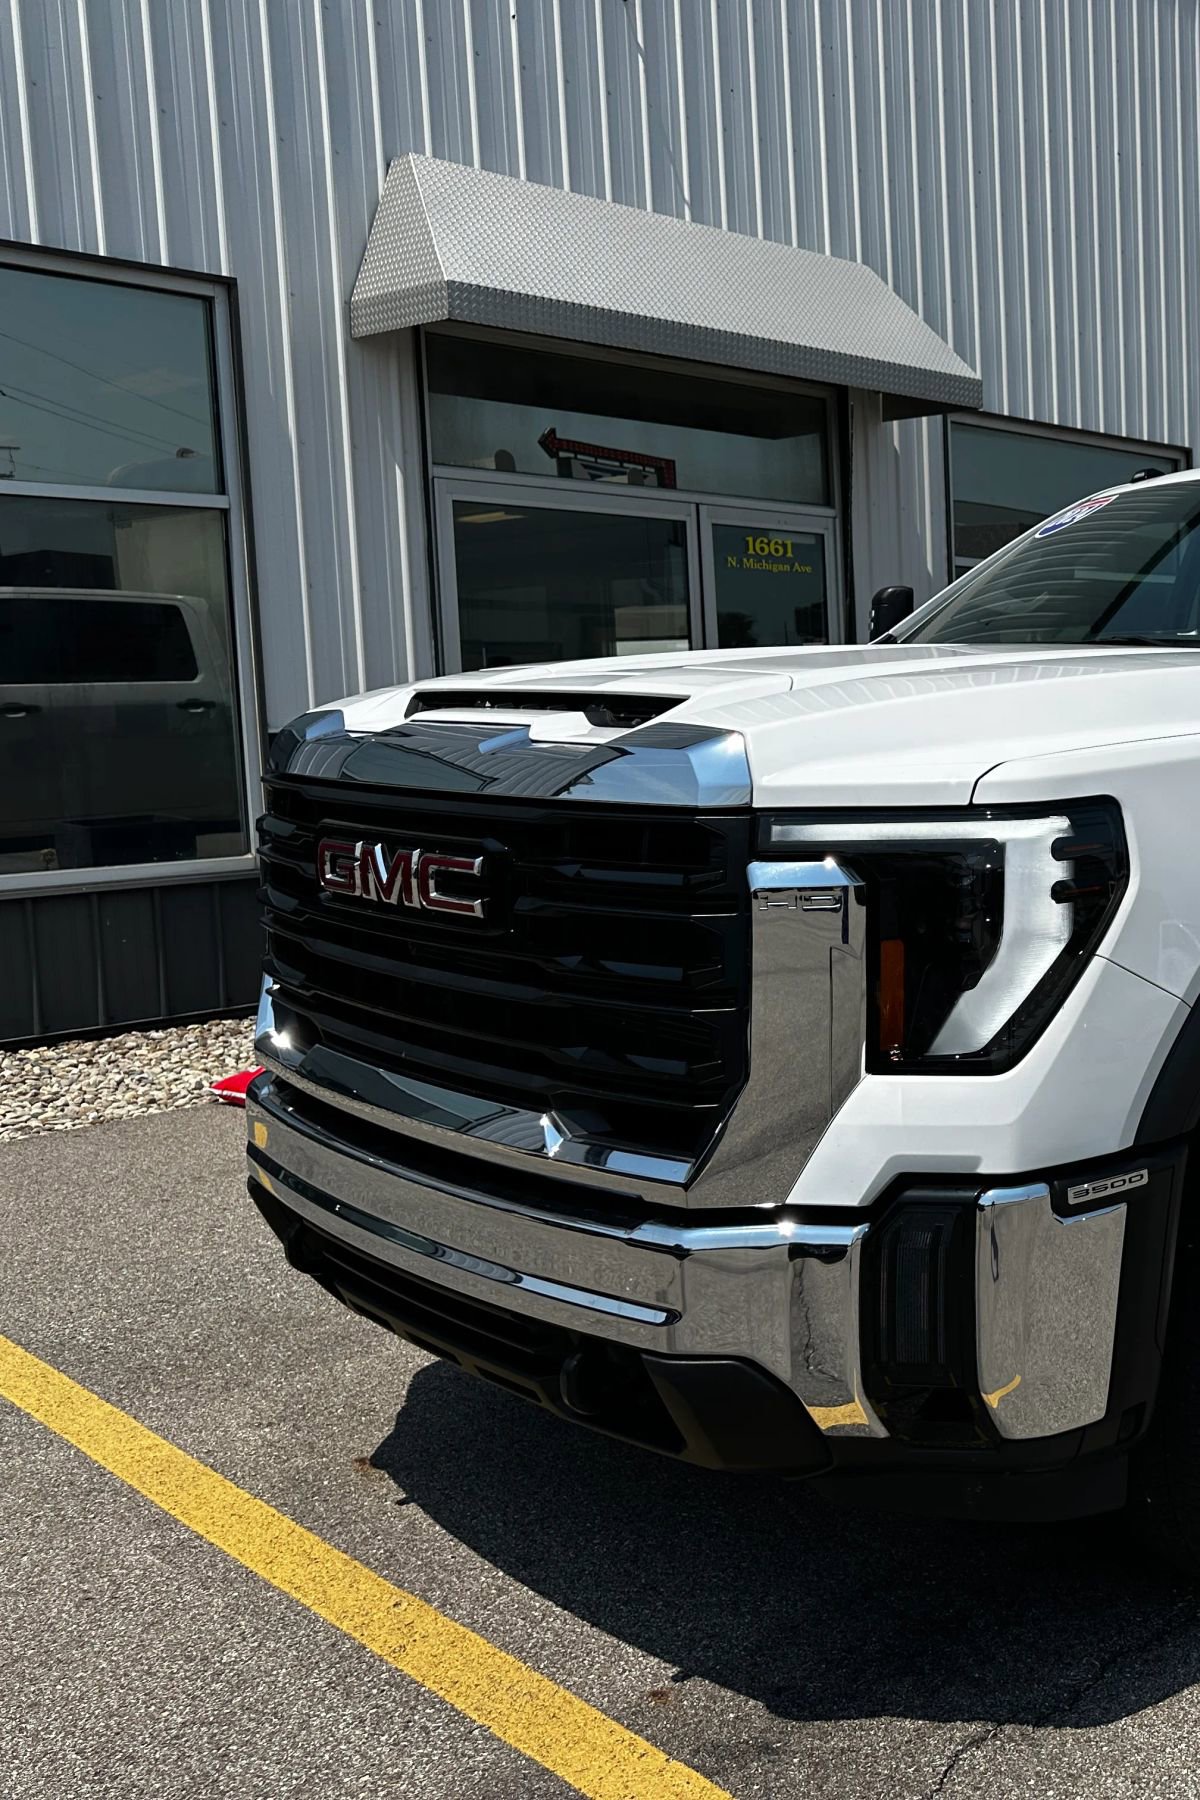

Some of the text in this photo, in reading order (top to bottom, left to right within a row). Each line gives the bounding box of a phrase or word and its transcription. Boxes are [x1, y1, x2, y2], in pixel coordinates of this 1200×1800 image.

[745, 535, 793, 558] 1661
[728, 558, 812, 573] N. Michigan Ave
[318, 836, 484, 918] GMC
[1072, 1173, 1144, 1199] 3500
